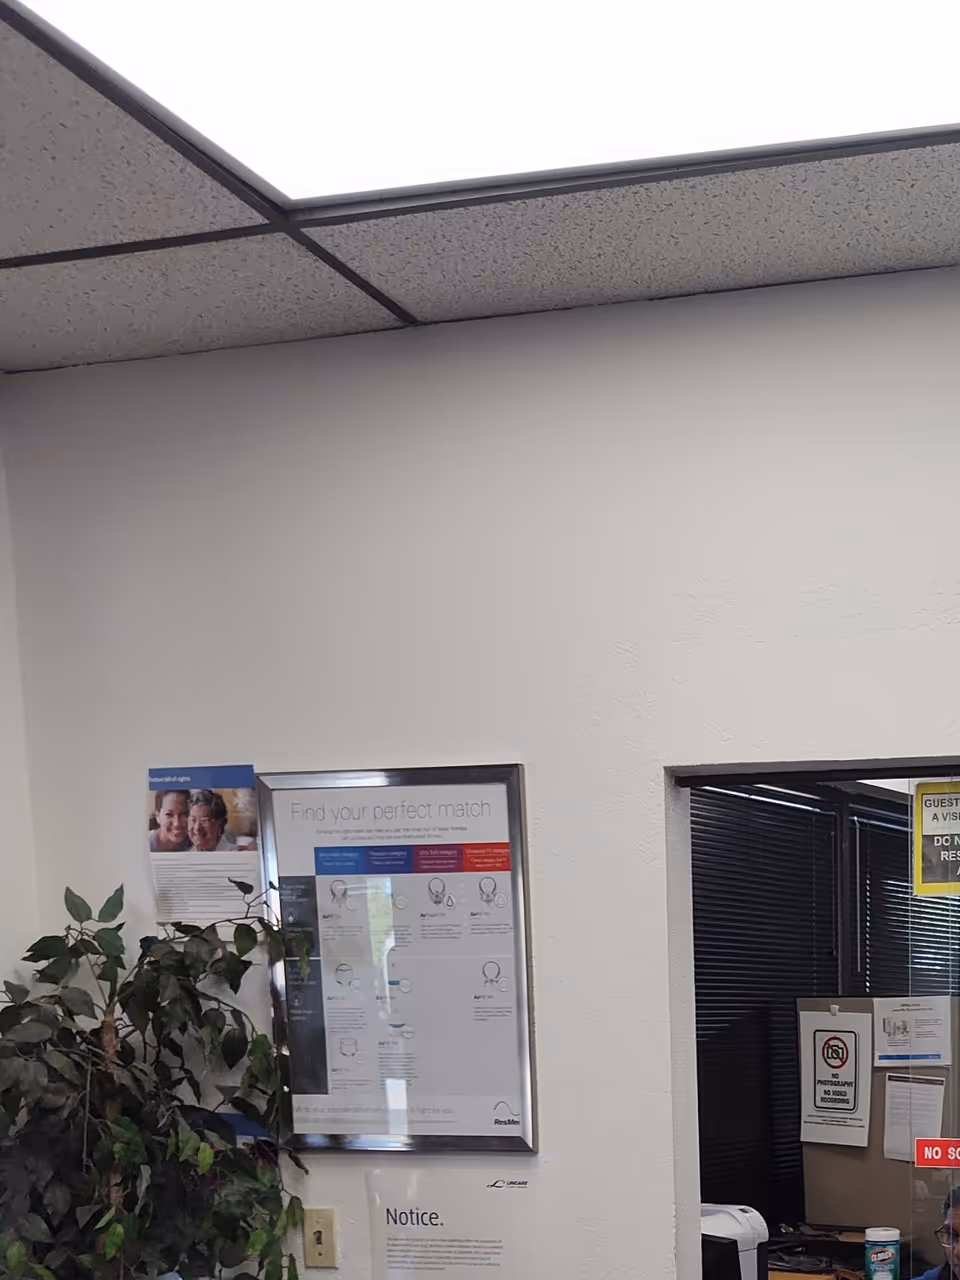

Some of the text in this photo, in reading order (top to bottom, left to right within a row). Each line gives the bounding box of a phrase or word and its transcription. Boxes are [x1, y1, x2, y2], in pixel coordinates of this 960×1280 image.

[291, 800, 491, 824] Find your perfect match
[931, 813, 939, 821] A
[934, 836, 951, 846] DO
[924, 1146, 941, 1159] NO
[386, 1207, 444, 1226] Notice.
